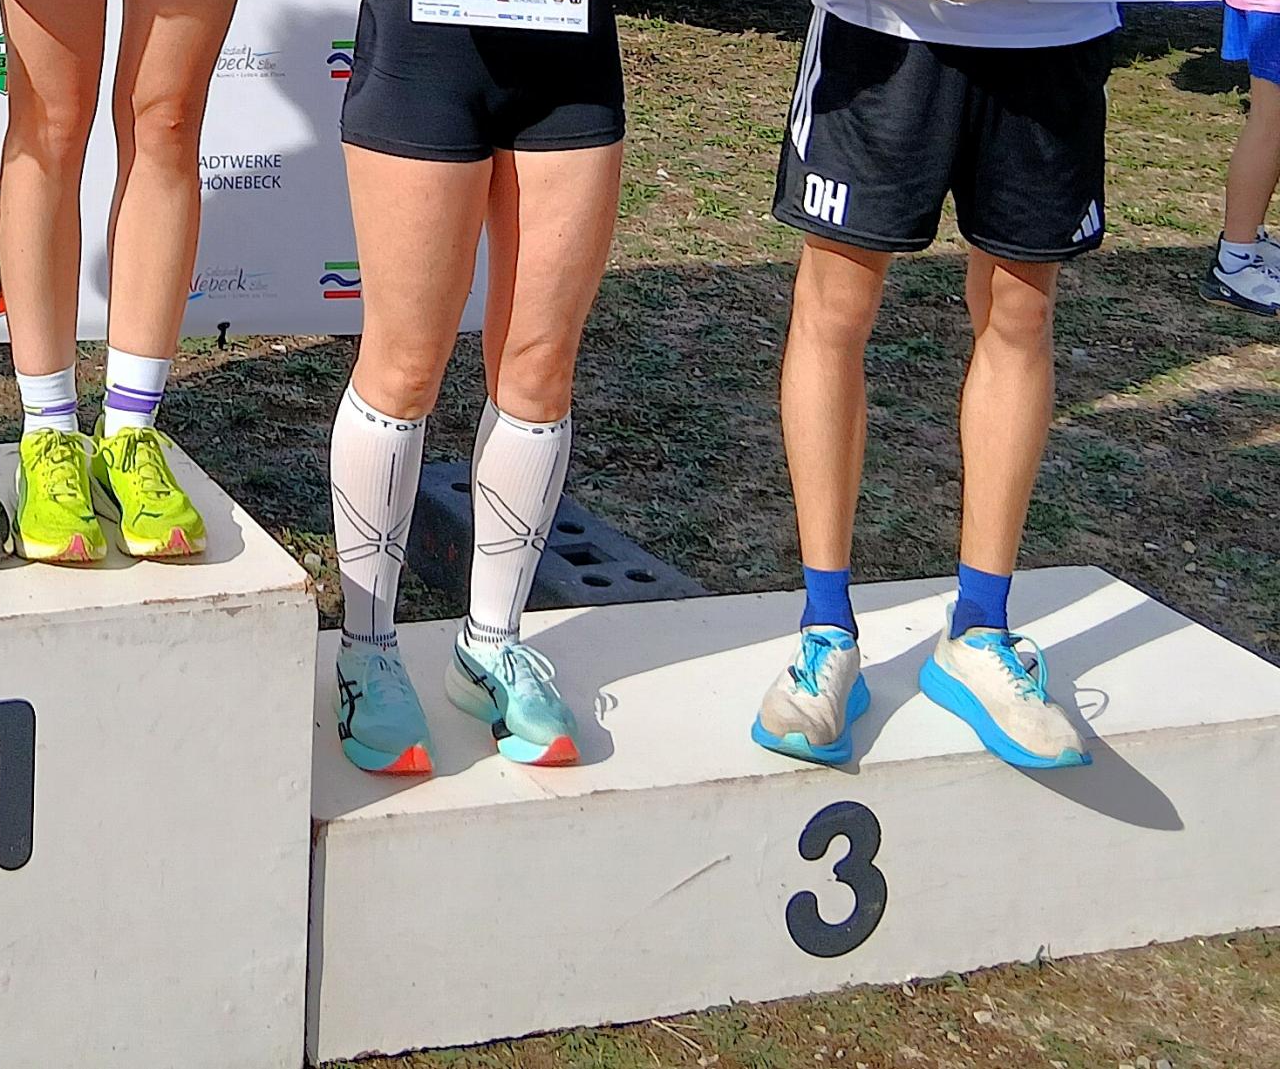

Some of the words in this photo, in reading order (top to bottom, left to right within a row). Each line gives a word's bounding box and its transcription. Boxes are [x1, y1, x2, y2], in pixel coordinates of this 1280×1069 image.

[199, 153, 282, 170] ADTWERKE
[200, 174, 282, 191] HÖNEBECK
[803, 172, 850, 226] OH
[785, 800, 888, 958] 3
